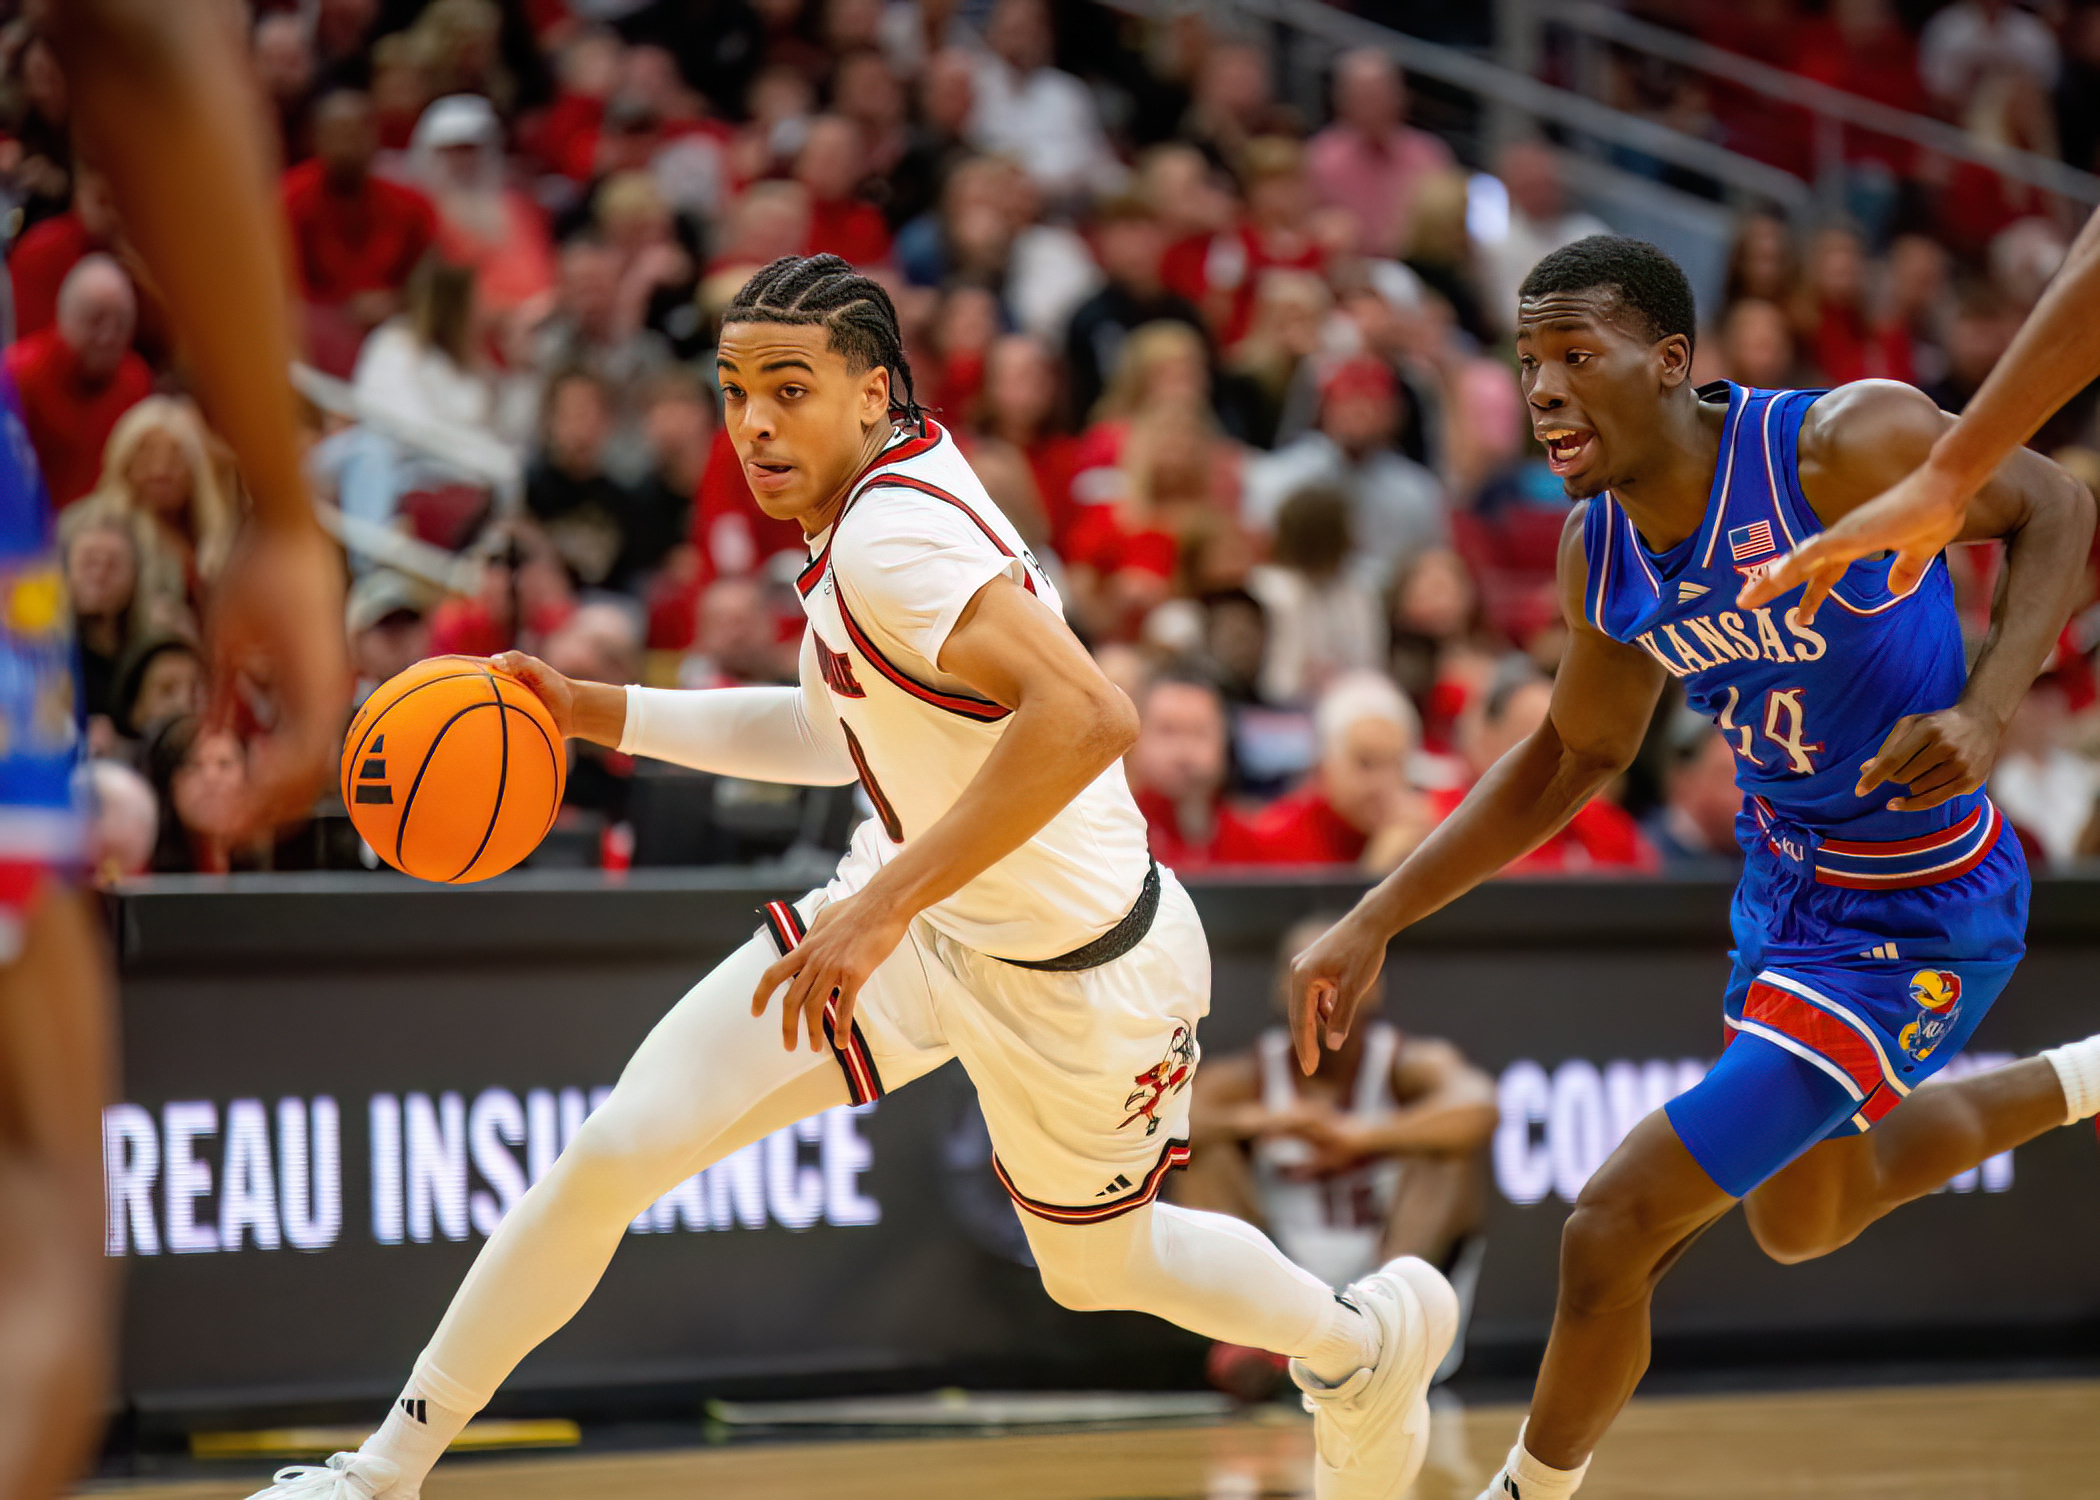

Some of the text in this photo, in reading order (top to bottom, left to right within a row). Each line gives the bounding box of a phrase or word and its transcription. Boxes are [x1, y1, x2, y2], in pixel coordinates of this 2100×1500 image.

[1635, 607, 1827, 678] KANSAS
[1782, 837, 1804, 862] KU
[102, 1085, 882, 1257] REAU INSNCE
